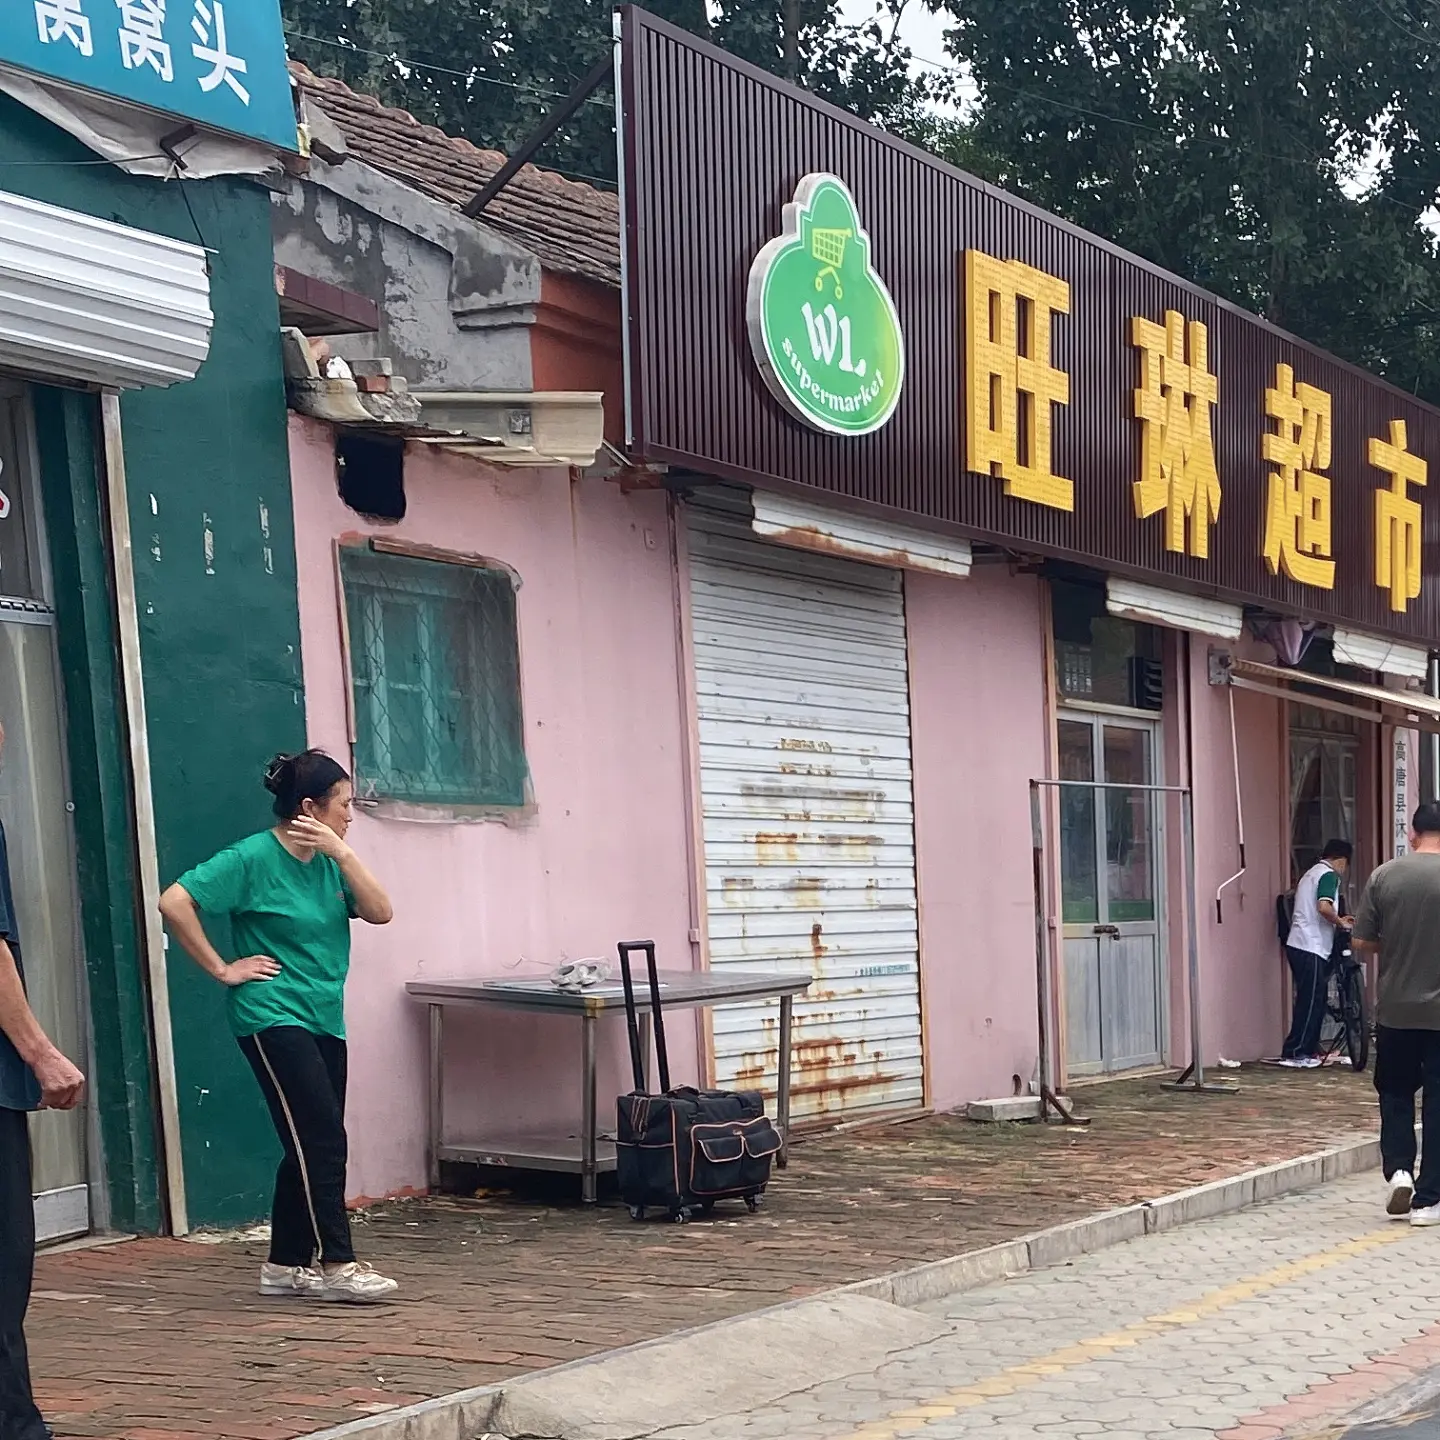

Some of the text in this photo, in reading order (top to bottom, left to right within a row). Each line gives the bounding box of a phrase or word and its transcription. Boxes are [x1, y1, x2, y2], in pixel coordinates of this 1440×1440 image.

[781, 337, 884, 412] supermarket
[801, 301, 866, 377] WL
[965, 248, 1427, 612] 旺琳超市
